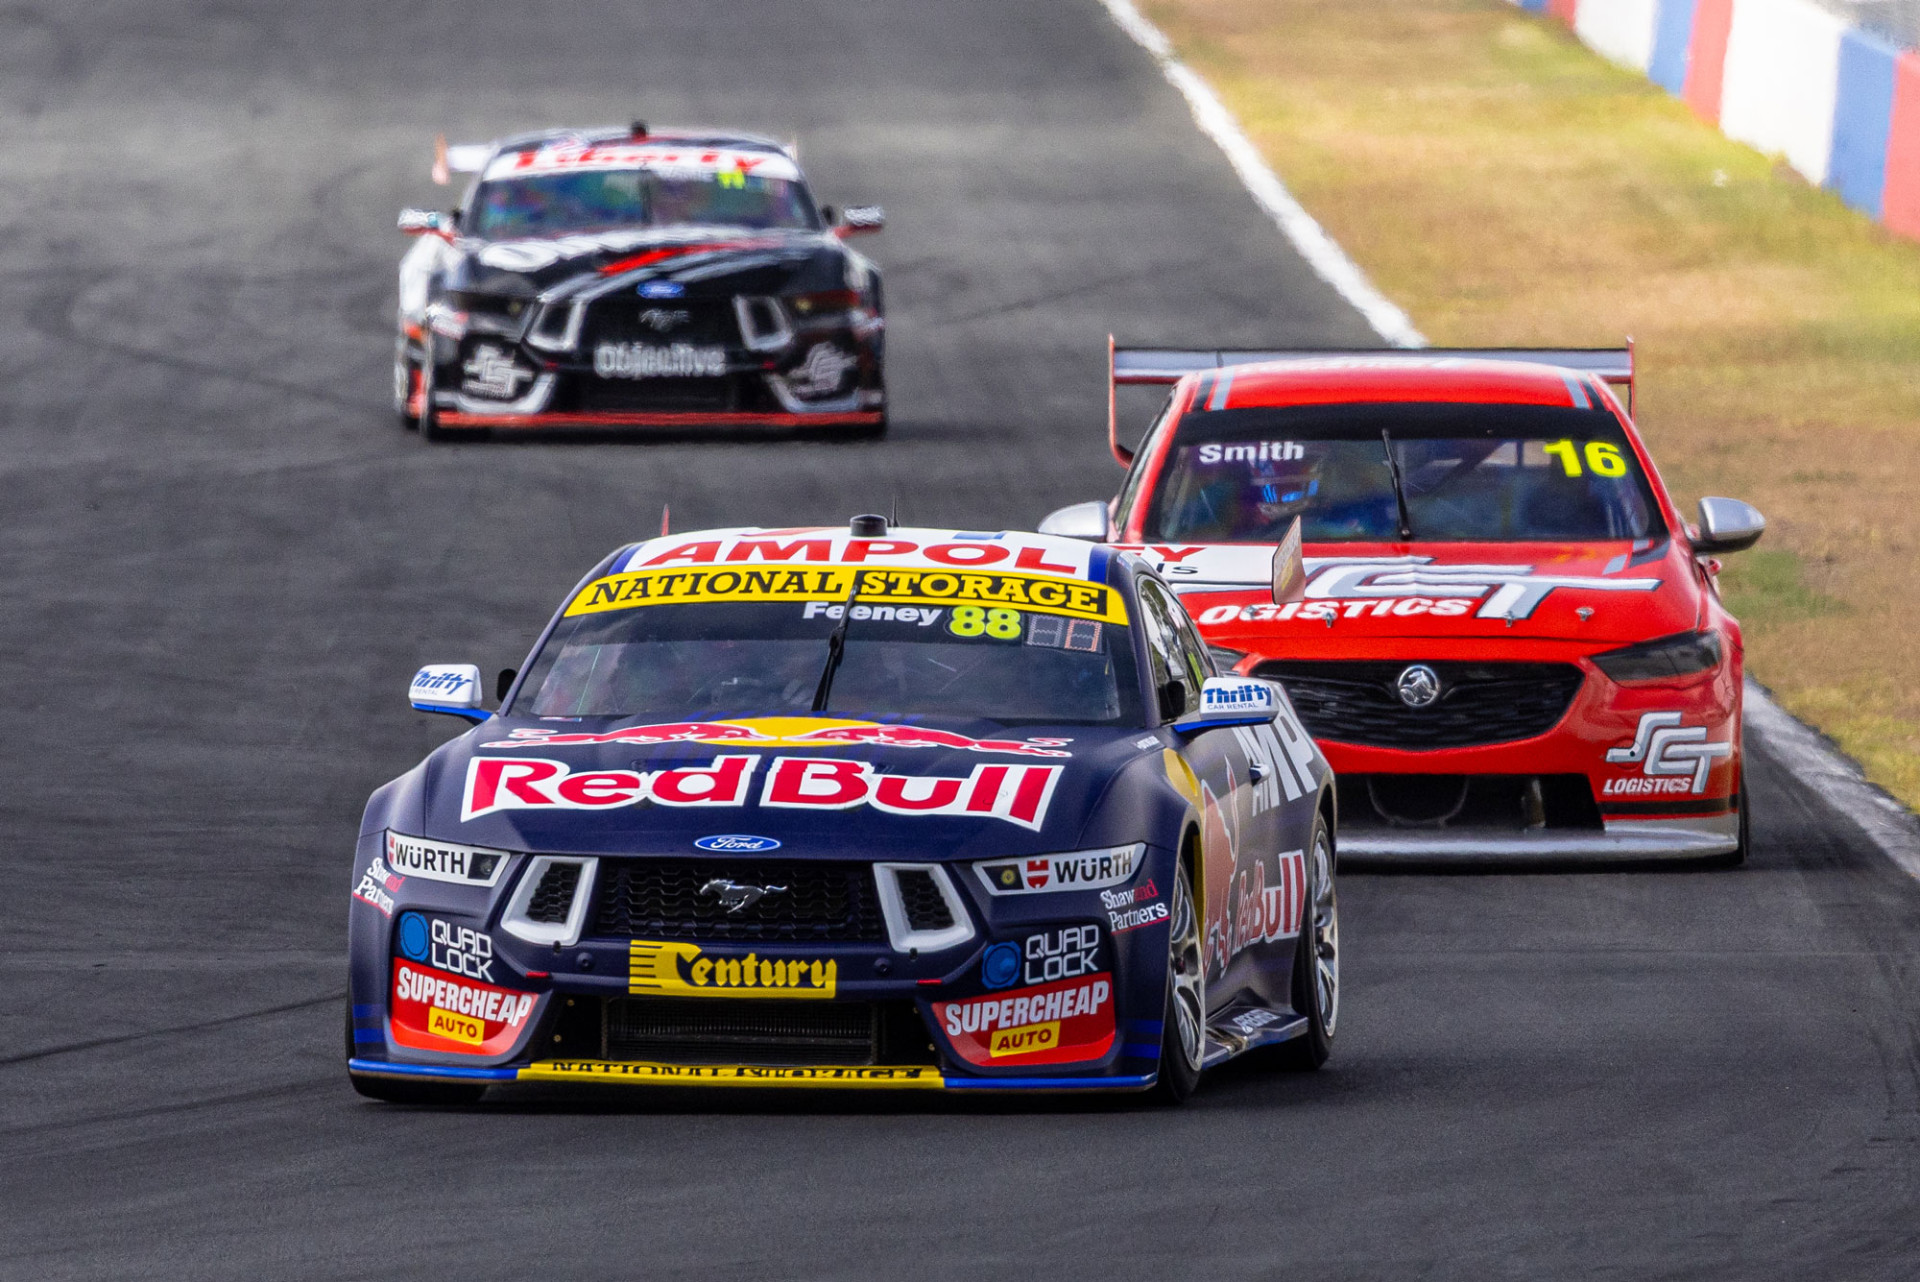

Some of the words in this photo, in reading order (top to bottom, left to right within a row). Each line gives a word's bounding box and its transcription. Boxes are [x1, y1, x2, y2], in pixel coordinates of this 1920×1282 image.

[1199, 441, 1304, 465] Smith
[1543, 438, 1627, 478] 16
[639, 540, 1078, 575] AMPOL
[585, 571, 843, 606] NATIONAL
[859, 571, 1100, 613] STORAGE
[803, 602, 944, 627] Feeney
[949, 605, 1022, 640] 88
[1195, 598, 1474, 627] OGISTICS
[1203, 684, 1272, 707] Thrifty
[1605, 711, 1731, 794] SCT
[463, 756, 760, 821] Red
[760, 757, 1064, 831] Bull
[1602, 777, 1692, 795] LOGISTICS
[710, 837, 764, 849] Ford
[1108, 901, 1170, 933] Partners
[431, 918, 493, 959] QUAD
[1026, 924, 1099, 960] QUAD
[431, 943, 495, 983] LOCK
[640, 941, 838, 997] Century
[1024, 948, 1099, 985] LOCK
[396, 966, 533, 1028] SUPERCHEAP
[945, 980, 1110, 1037] SUPERCHEAP
[434, 1015, 478, 1039] AUTO
[997, 1028, 1053, 1051] AUTO
